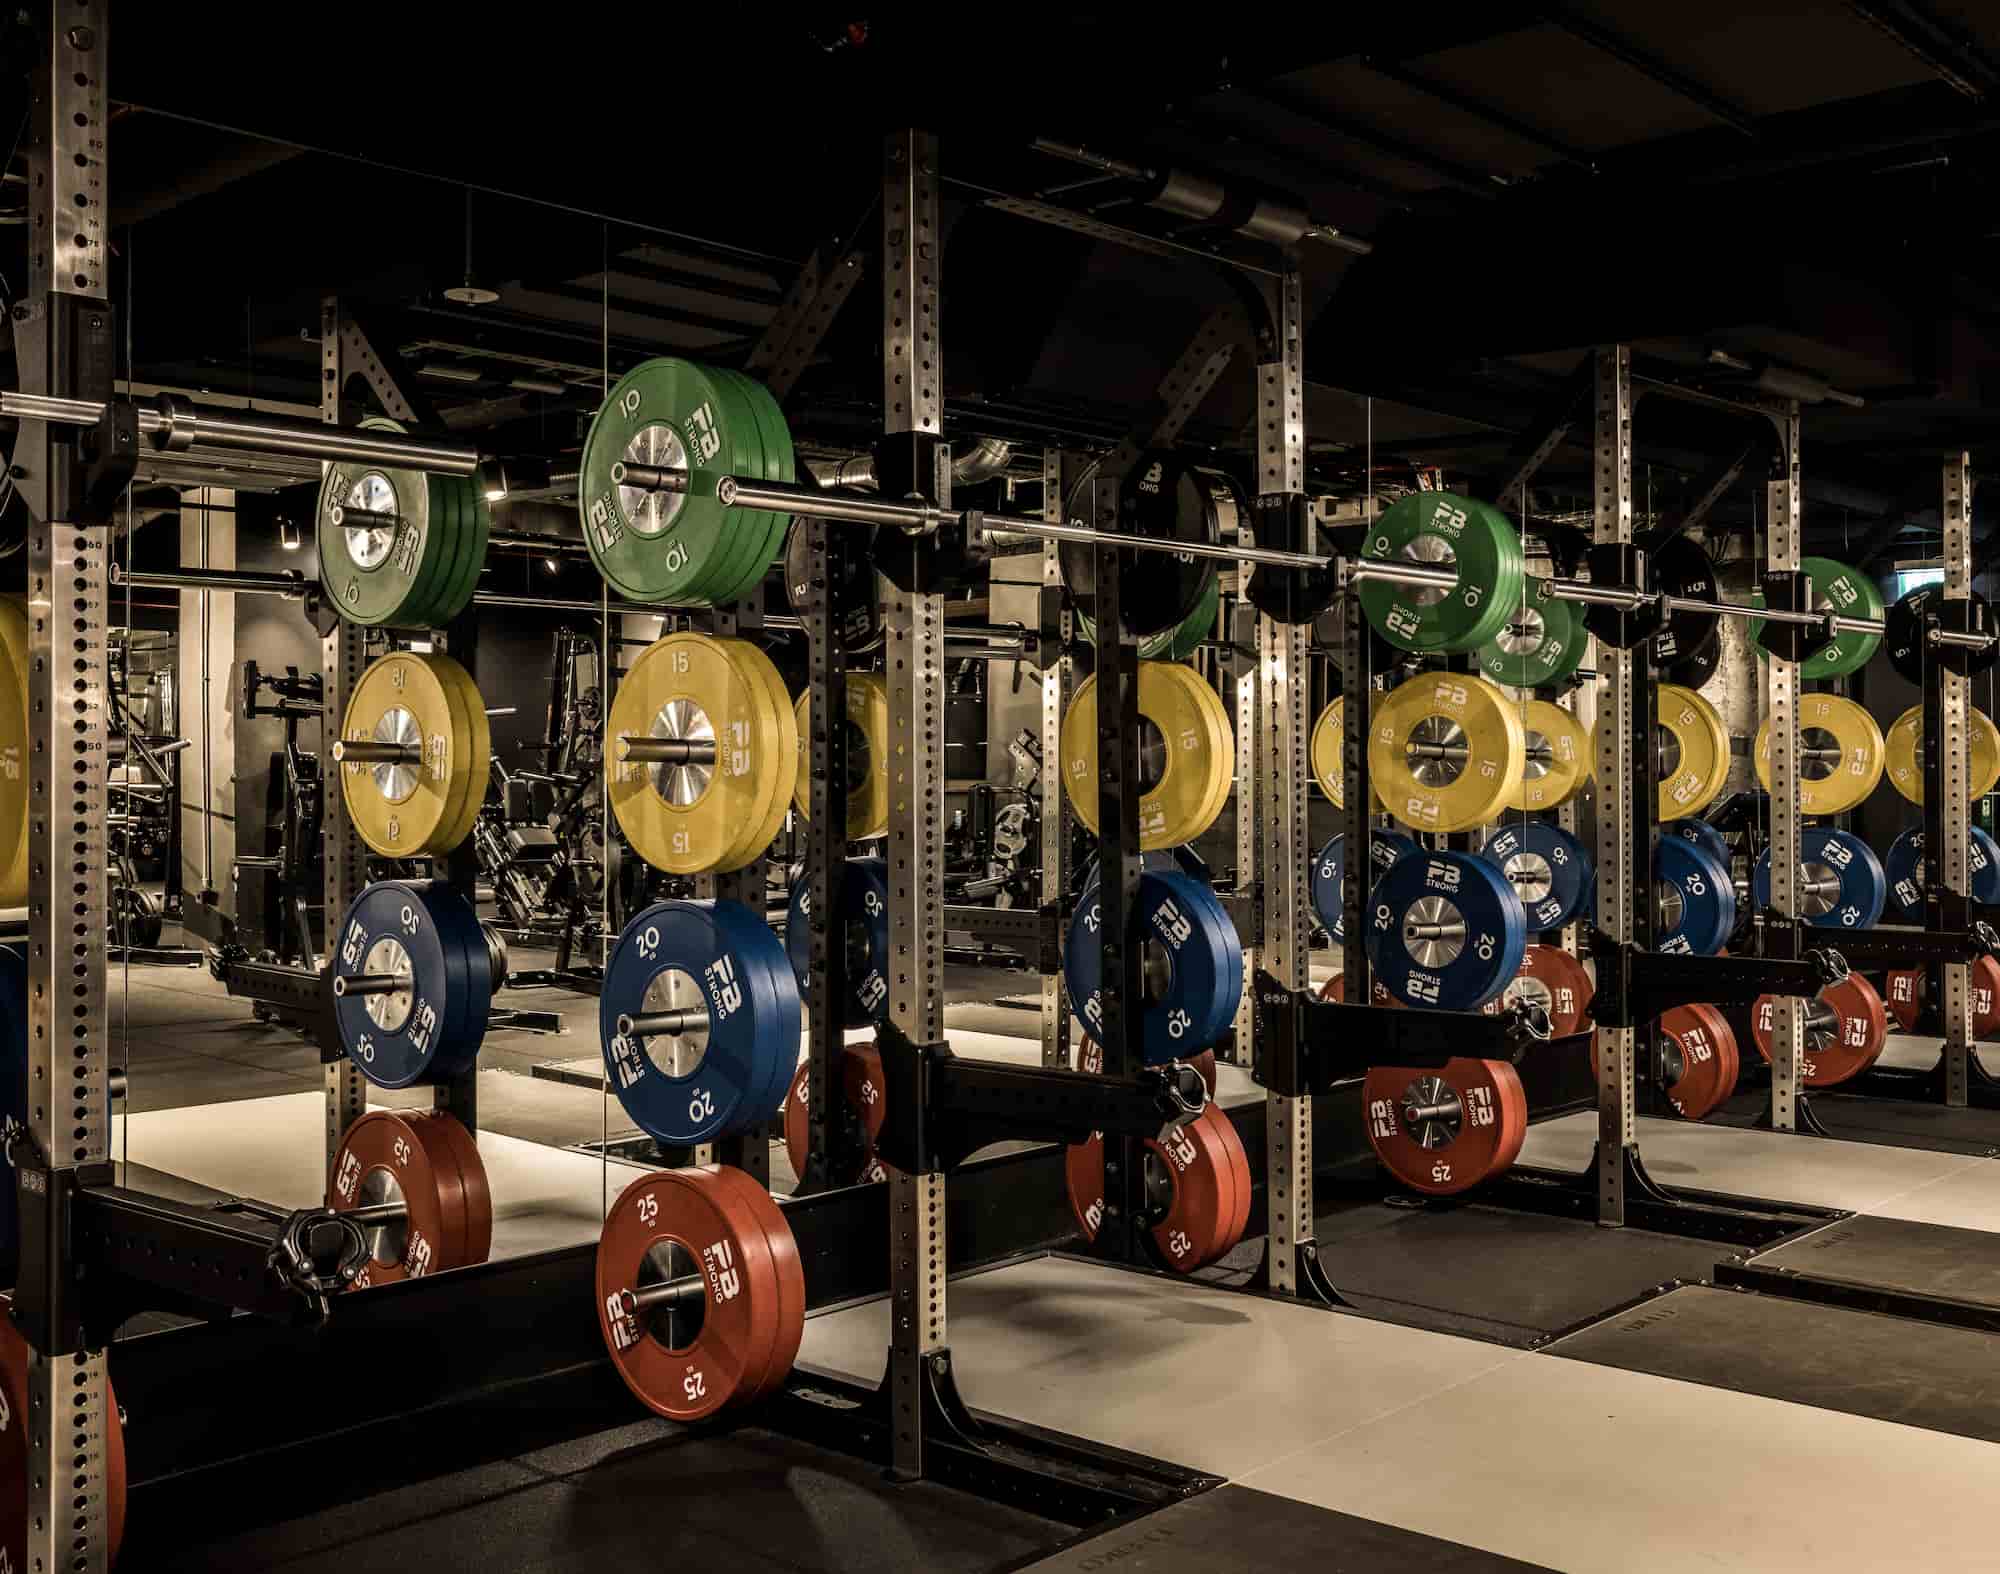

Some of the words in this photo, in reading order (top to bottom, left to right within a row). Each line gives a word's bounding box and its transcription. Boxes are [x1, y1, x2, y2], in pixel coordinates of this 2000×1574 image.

[620, 389, 641, 419] 10
[684, 418, 706, 467] STRONG
[666, 543, 689, 572] 10
[1372, 536, 1389, 557] 10
[1464, 585, 1483, 608] 10
[672, 651, 689, 673] 15
[1825, 646, 1843, 662] 10
[1181, 728, 1199, 750] 15
[1379, 727, 1395, 745] 15
[1072, 759, 1088, 780] 15
[1481, 760, 1497, 778] 15
[672, 832, 690, 855] 15
[1424, 879, 1460, 894] STRONG
[1688, 873, 1706, 896] 20
[1375, 904, 1391, 930] 20
[1841, 906, 1861, 926] 20
[636, 926, 661, 959] 20
[1152, 914, 1181, 950] STRONG
[1478, 933, 1495, 960] 20
[704, 967, 727, 1021] STRONG
[1168, 1009, 1191, 1039] 20
[689, 1091, 715, 1123] 20
[1432, 1164, 1452, 1182] 25
[637, 1193, 659, 1223] 25
[1170, 1231, 1192, 1258] 25
[703, 1248, 724, 1305] STRONG
[683, 1372, 706, 1402] 25
